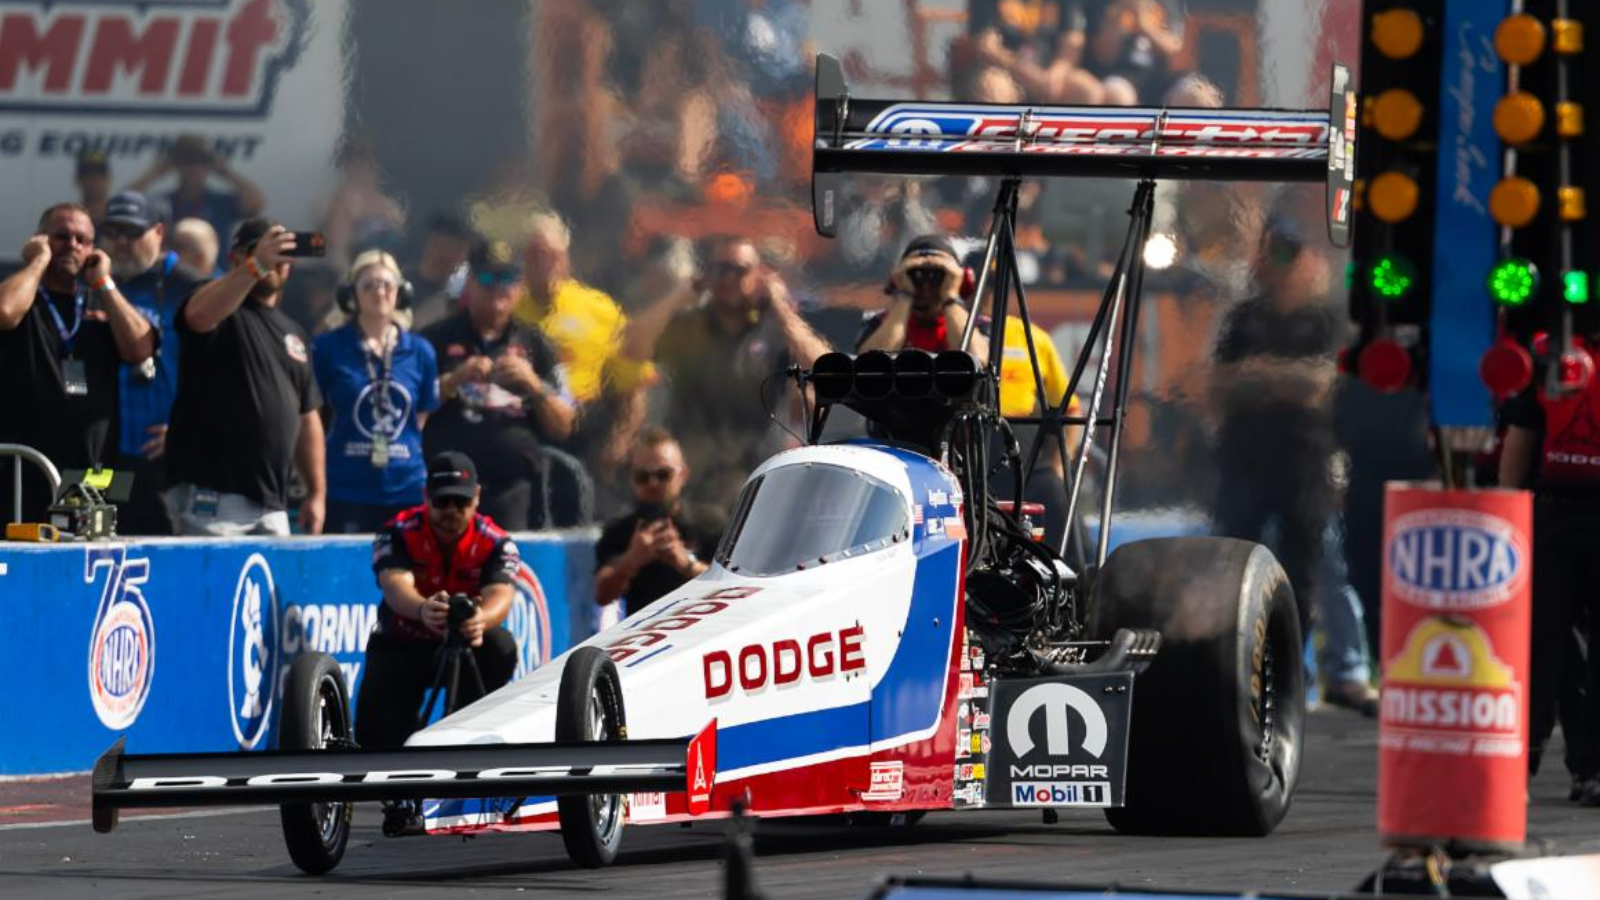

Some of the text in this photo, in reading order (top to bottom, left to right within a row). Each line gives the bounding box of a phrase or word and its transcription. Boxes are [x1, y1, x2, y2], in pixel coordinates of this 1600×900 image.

[39, 131, 263, 159] EQUIPNT
[1394, 531, 1513, 589] NHRA
[703, 625, 866, 700] DODGE
[127, 763, 684, 790] DODGE
[1009, 764, 1109, 778] MOPAR
[1015, 784, 1078, 803] Mobil
